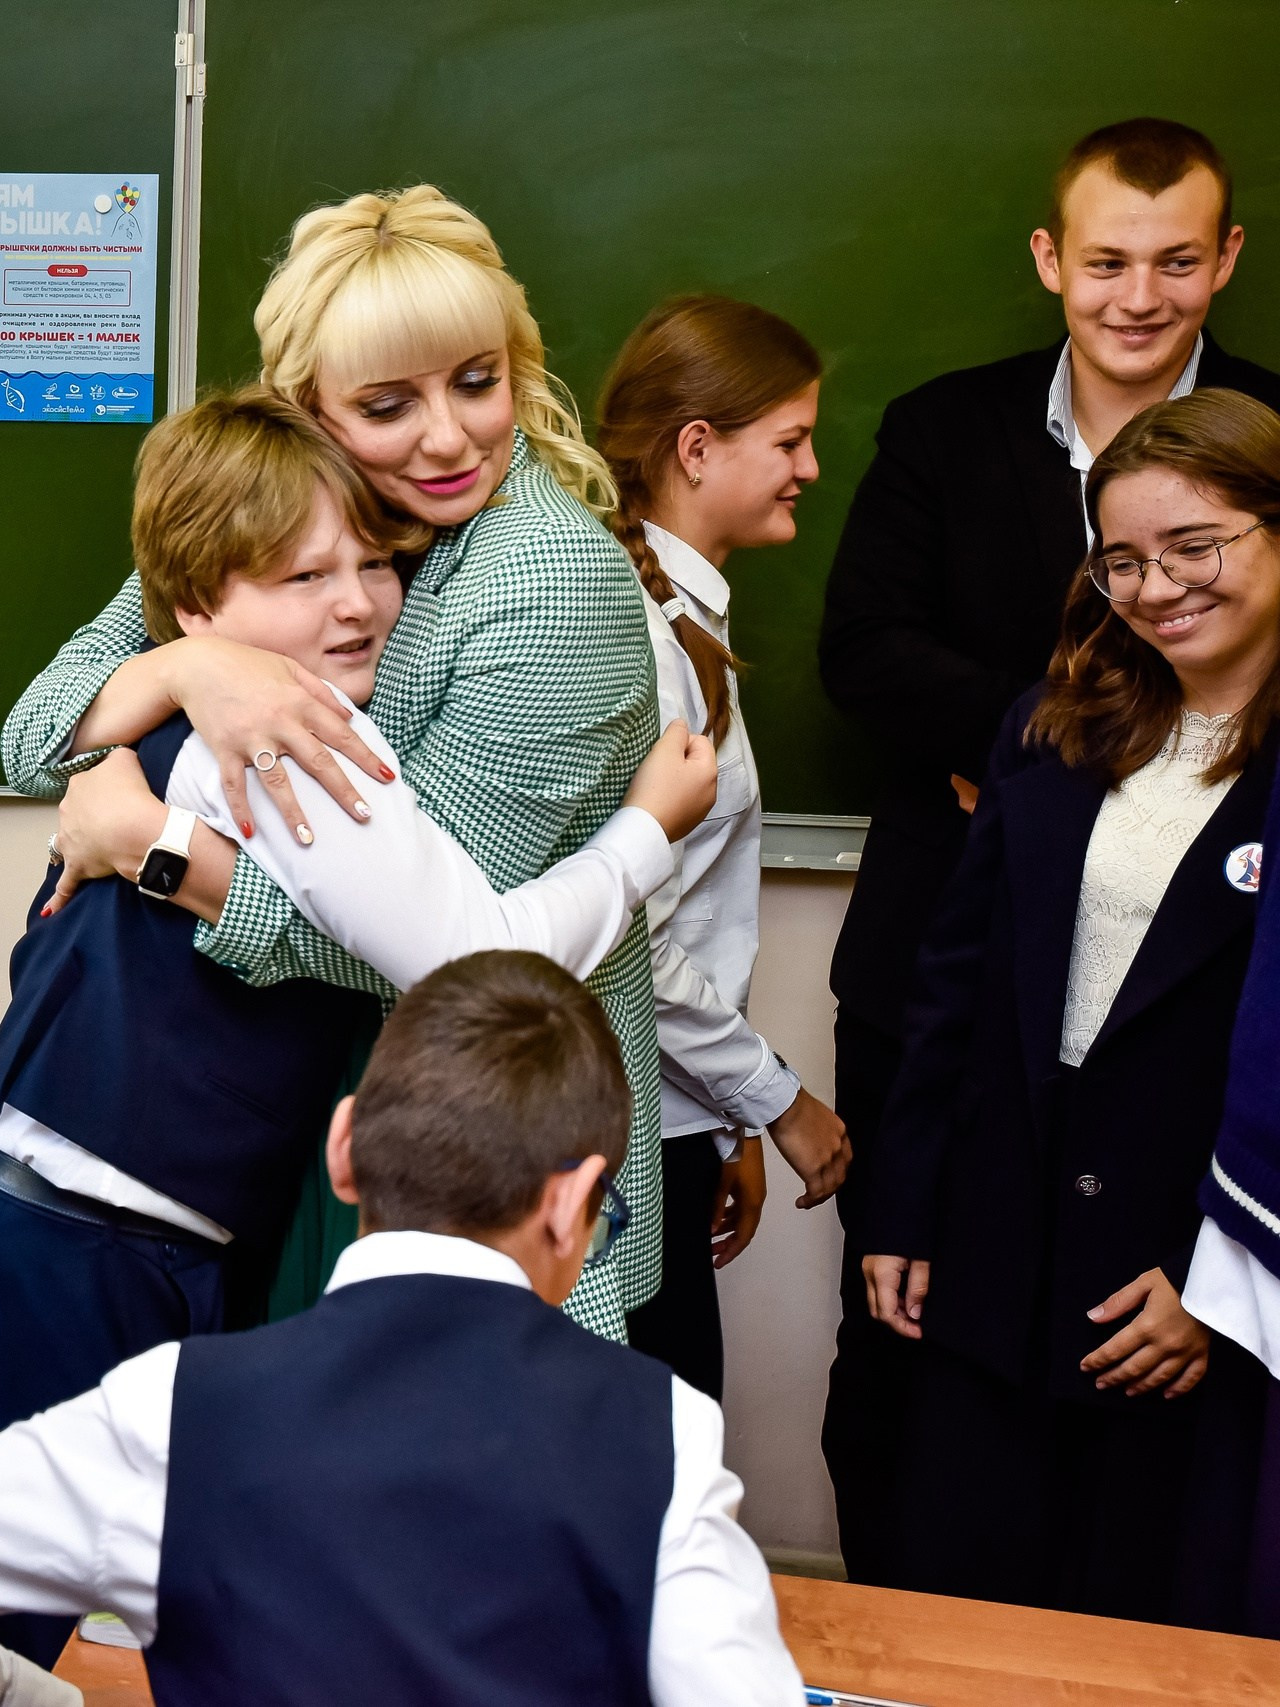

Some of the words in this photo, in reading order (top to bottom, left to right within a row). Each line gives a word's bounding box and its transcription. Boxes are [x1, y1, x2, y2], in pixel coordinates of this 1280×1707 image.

[41, 245, 78, 253] ДОЛЖНЫ
[20, 332, 75, 342] КРЫШЕК
[87, 333, 92, 342] 1
[96, 333, 141, 342] МАЛЕК
